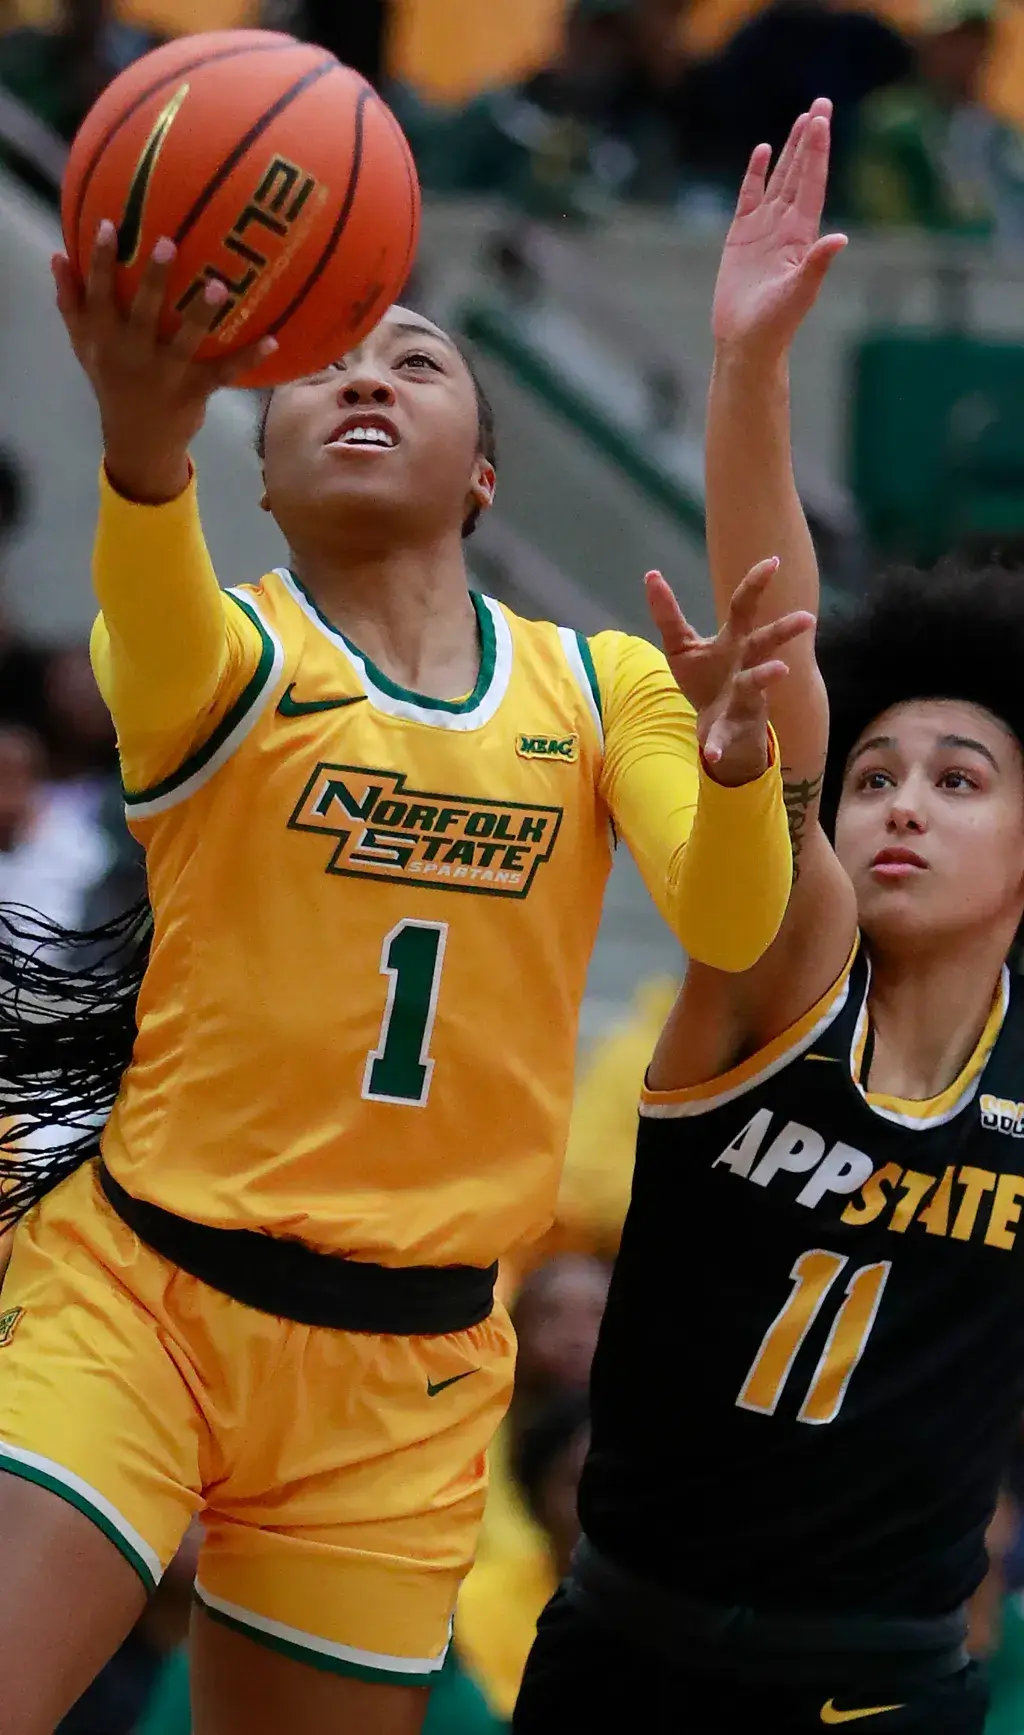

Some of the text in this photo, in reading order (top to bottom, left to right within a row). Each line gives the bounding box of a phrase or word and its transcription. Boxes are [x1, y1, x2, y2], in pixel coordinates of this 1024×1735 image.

[520, 736, 574, 758] MEAC
[310, 779, 548, 842] NORFOLK
[349, 828, 531, 871] STATE
[407, 860, 521, 884] SPARTANS
[361, 917, 449, 1108] 1
[735, 1249, 892, 1425] 11
